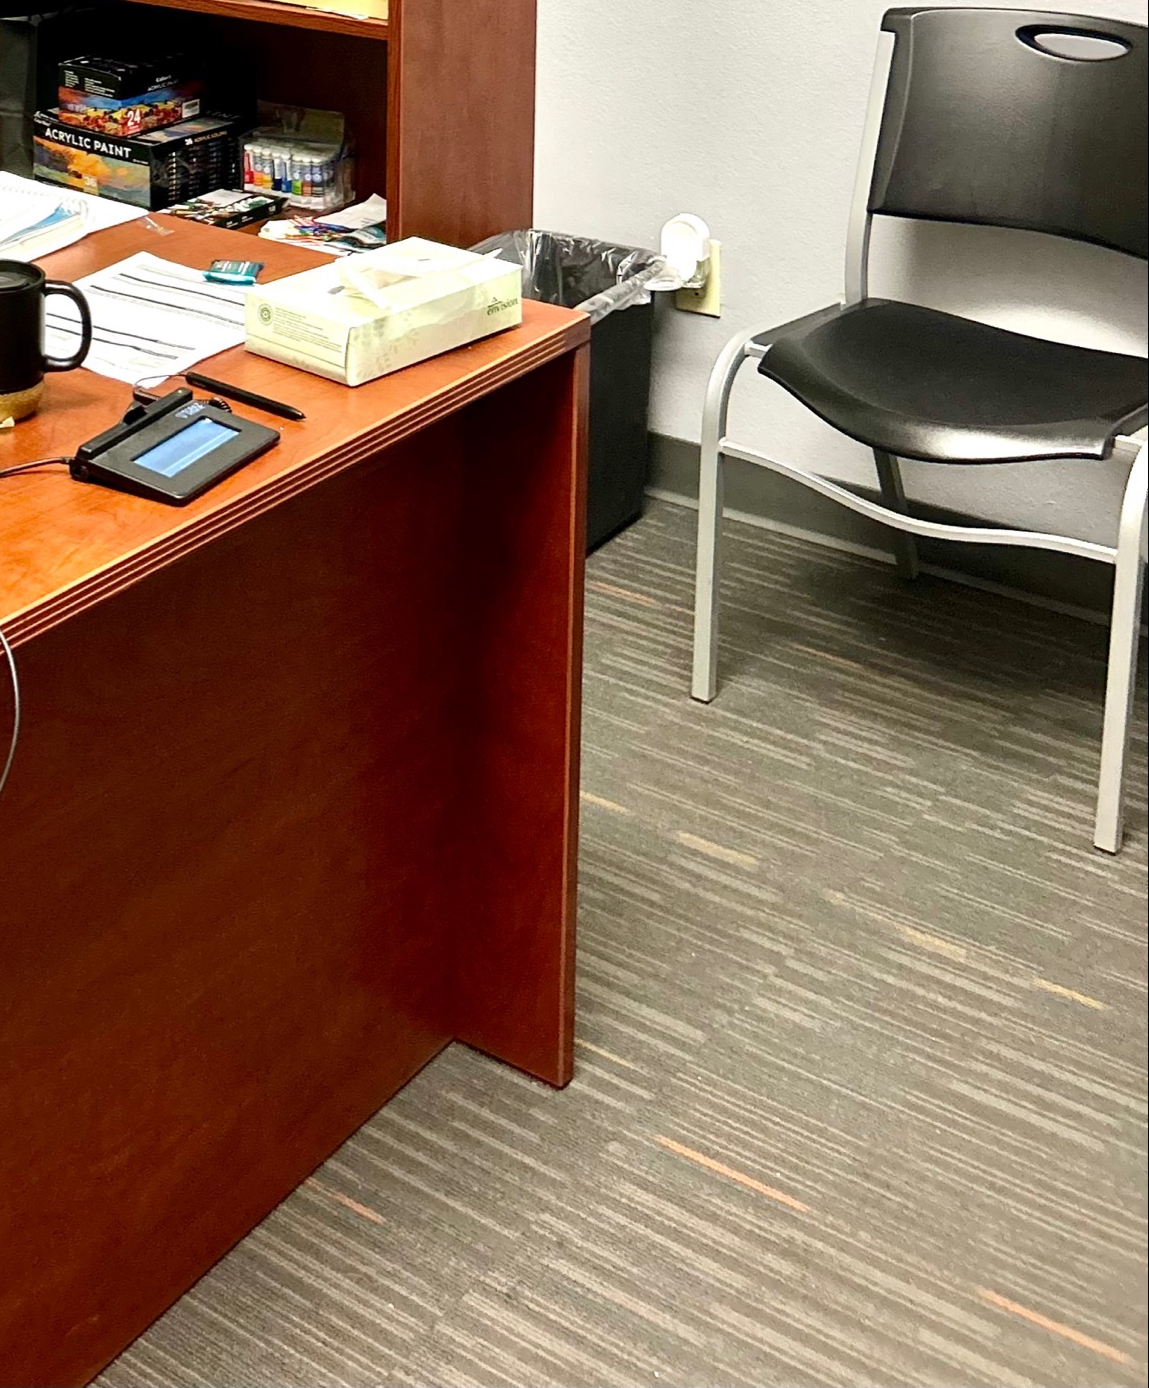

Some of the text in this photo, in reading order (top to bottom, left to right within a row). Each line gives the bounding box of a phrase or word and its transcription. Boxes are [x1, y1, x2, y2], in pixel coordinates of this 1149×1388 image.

[127, 108, 142, 127] 24
[45, 127, 132, 158] ACRYLIC PAINT
